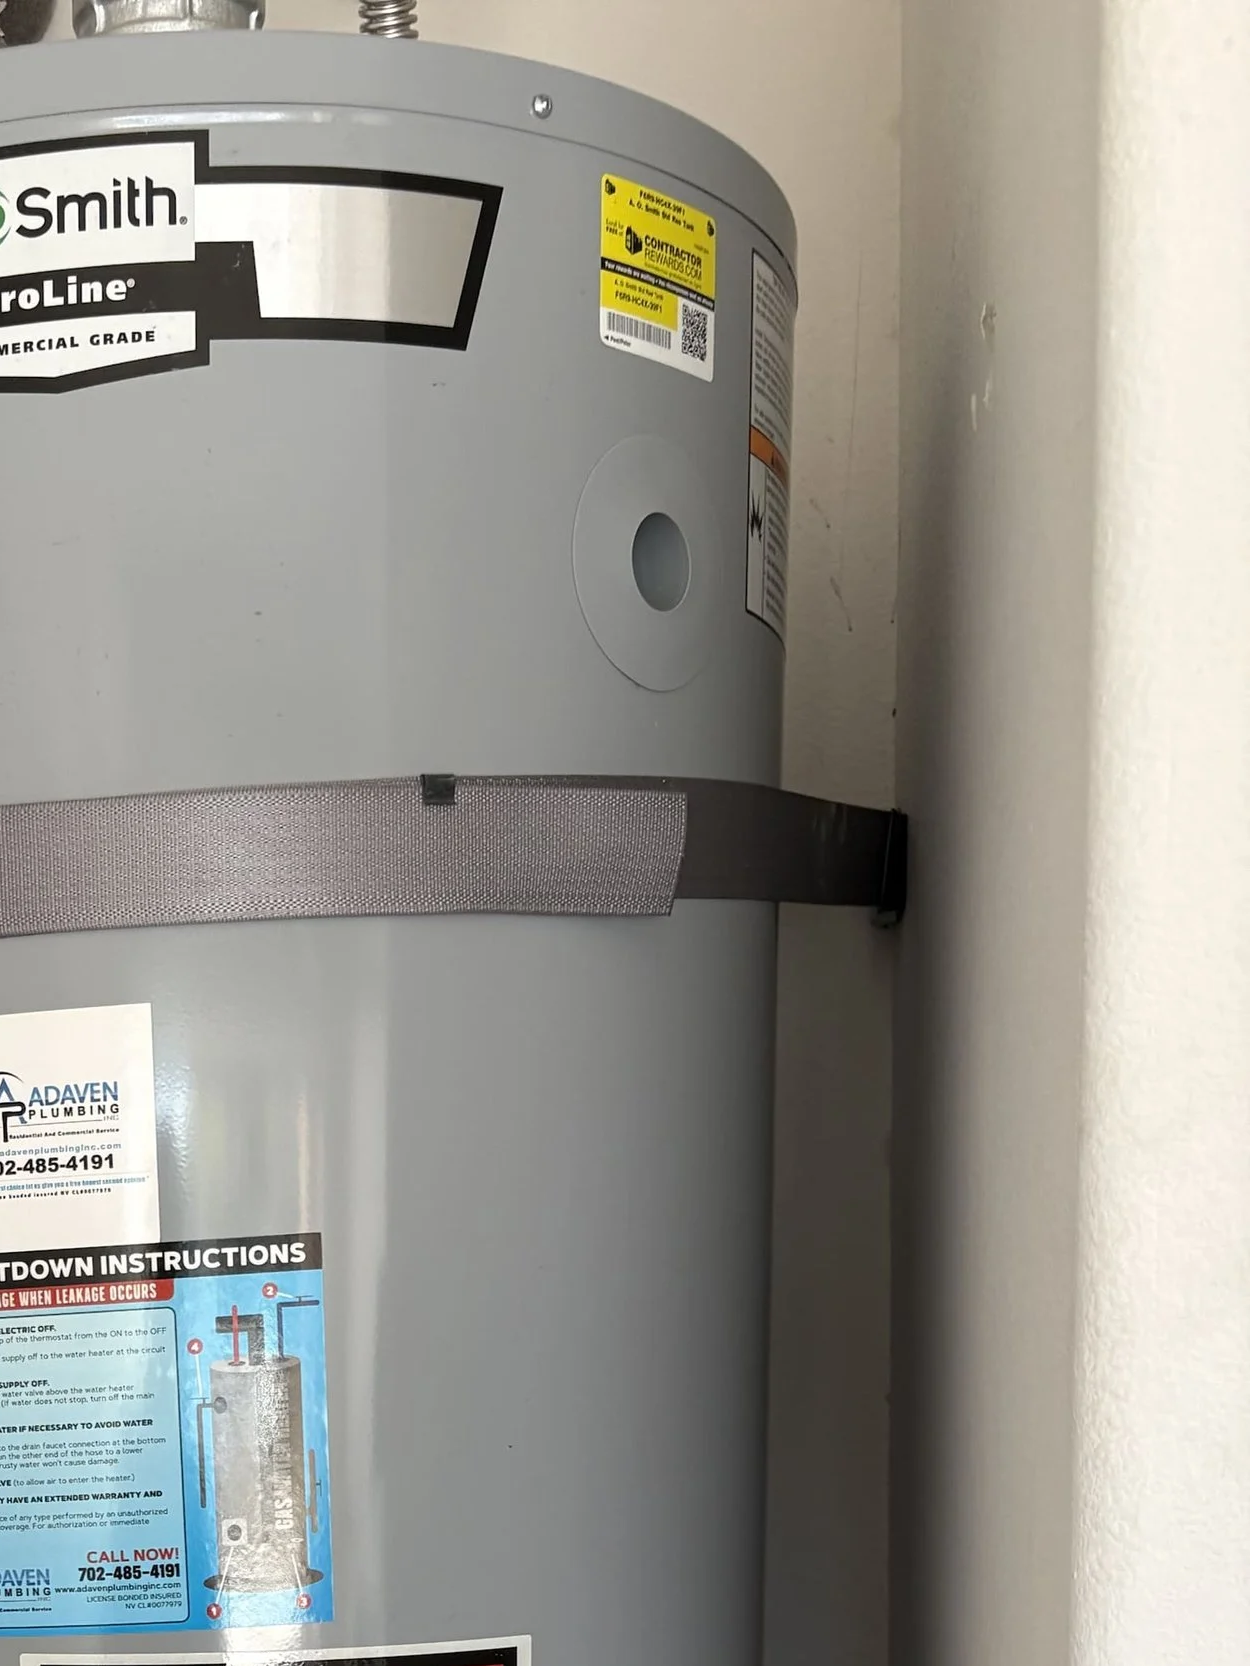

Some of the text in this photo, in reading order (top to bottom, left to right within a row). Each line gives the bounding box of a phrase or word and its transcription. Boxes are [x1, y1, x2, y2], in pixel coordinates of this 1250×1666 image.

[645, 235, 702, 268] CONTRACTOR
[645, 248, 702, 280] REWARDS.COM
[90, 330, 156, 346] GRADE
[29, 1081, 118, 1107] ADAVEN
[29, 1104, 119, 1120] PLUMBING
[101, 1243, 306, 1277] INSTRUCTIONS
[20, 1290, 52, 1308] WHEN
[55, 1287, 105, 1305] LEAKAGE
[109, 1283, 157, 1302] OCCURS
[38, 1325, 56, 1333] OFF.
[274, 1498, 294, 1530] GAS
[87, 1548, 179, 1563] CALL NOW!
[78, 1563, 180, 1582] 702-485-4191
[55, 1582, 181, 1594] www.adavenplumbinginc.com
